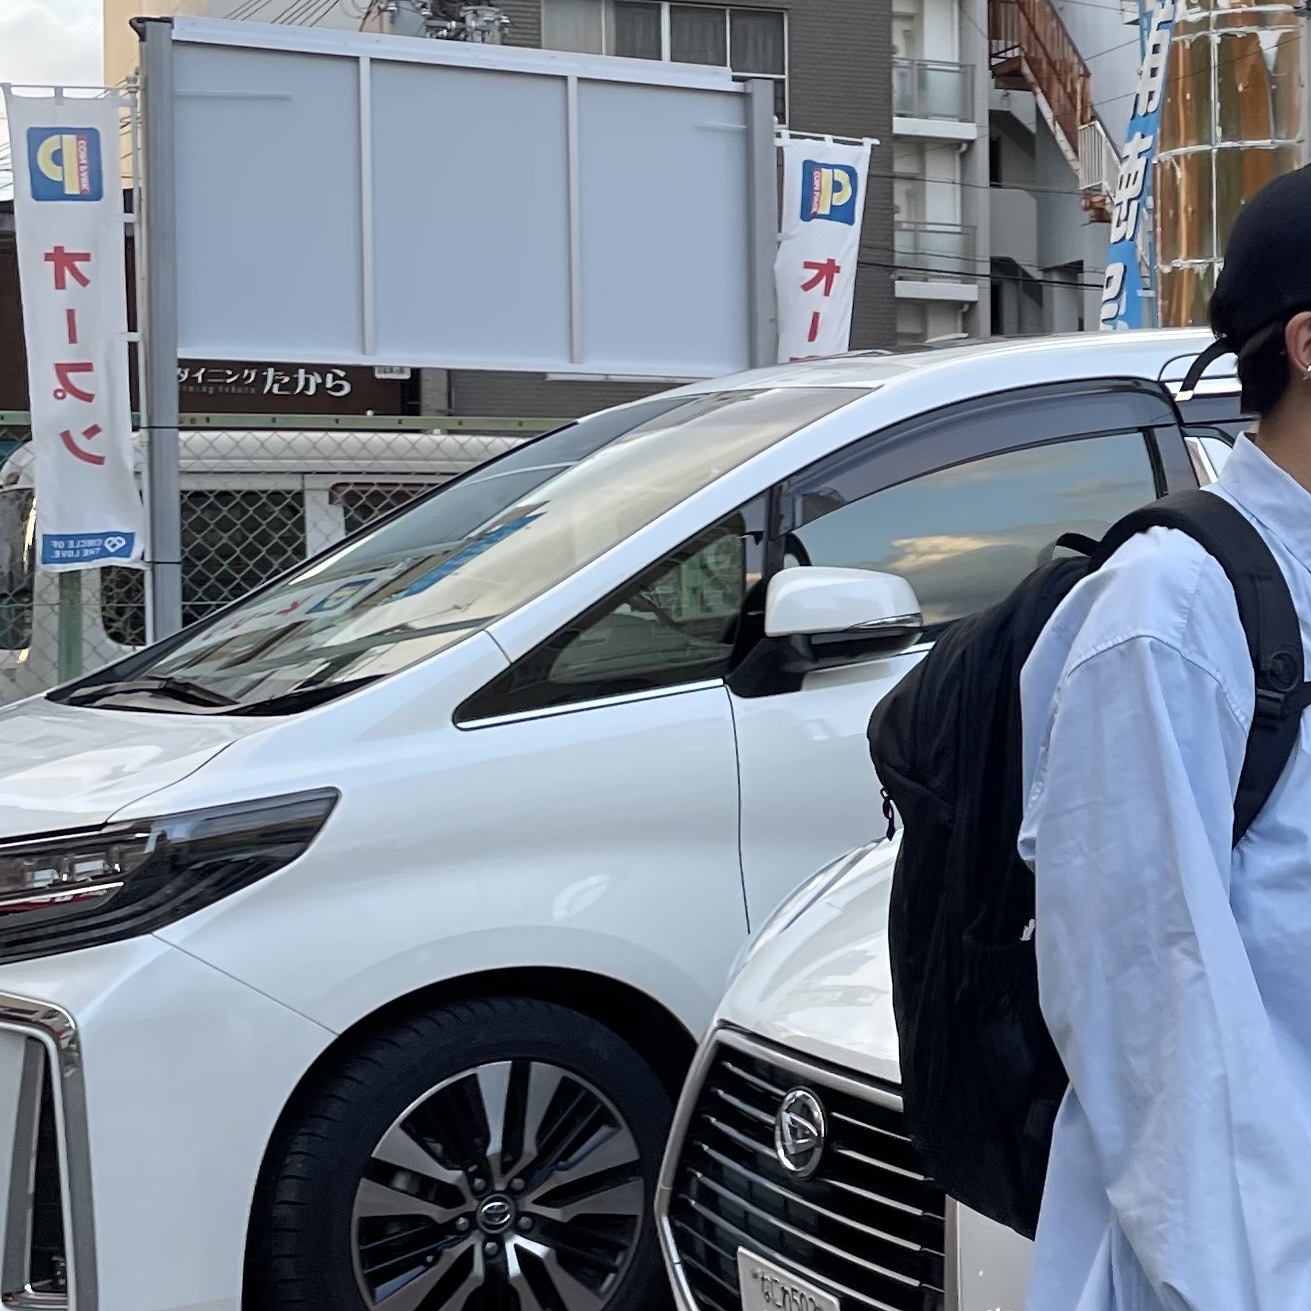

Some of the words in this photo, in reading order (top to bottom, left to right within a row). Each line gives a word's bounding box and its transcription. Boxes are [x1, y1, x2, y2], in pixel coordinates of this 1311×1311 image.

[790, 259, 841, 361] オー
[263, 367, 351, 397] たから
